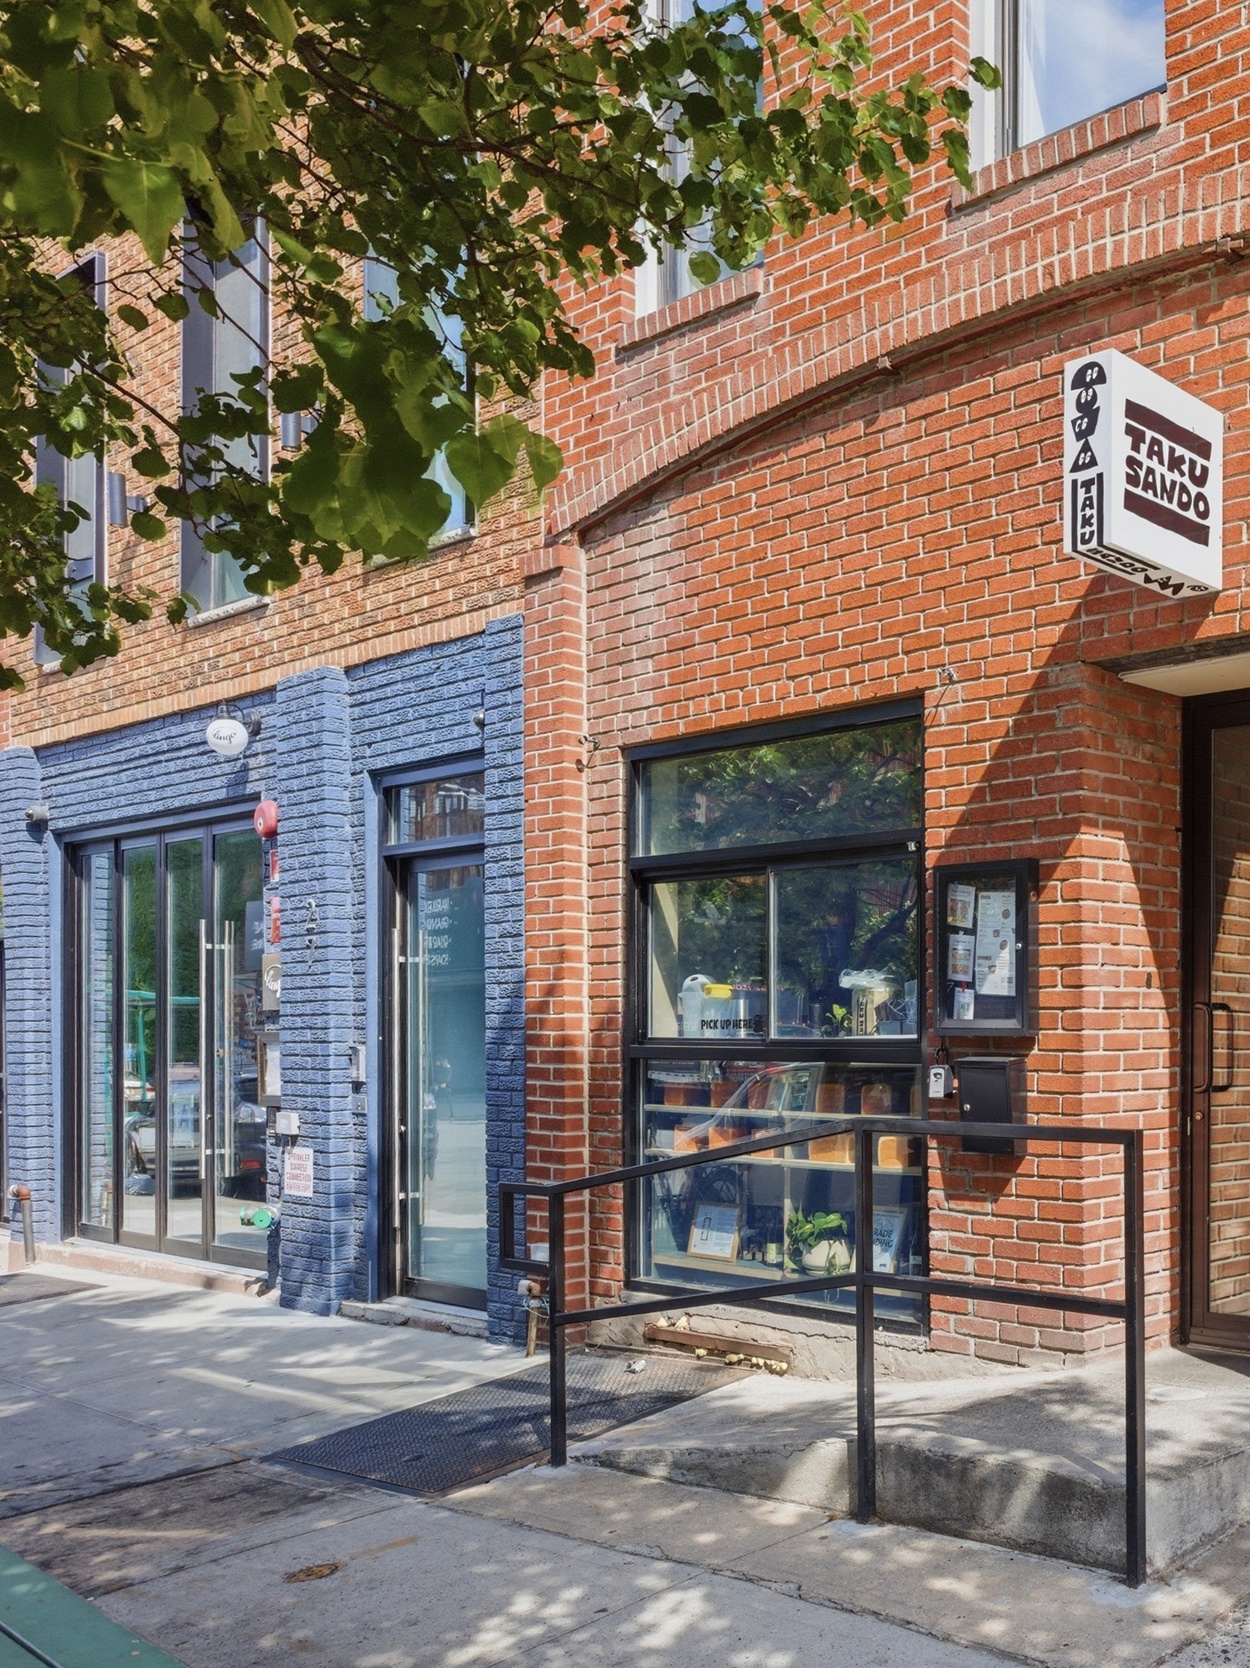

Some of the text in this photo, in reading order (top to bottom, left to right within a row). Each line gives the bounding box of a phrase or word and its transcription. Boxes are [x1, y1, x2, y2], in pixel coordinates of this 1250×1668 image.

[1124, 421, 1210, 489] TAKU
[1124, 455, 1211, 521] SANDO
[1079, 476, 1096, 546] TAKU
[700, 1018, 718, 1030] PICK
[720, 1018, 731, 1030] UP
[732, 1018, 754, 1030] HERE
